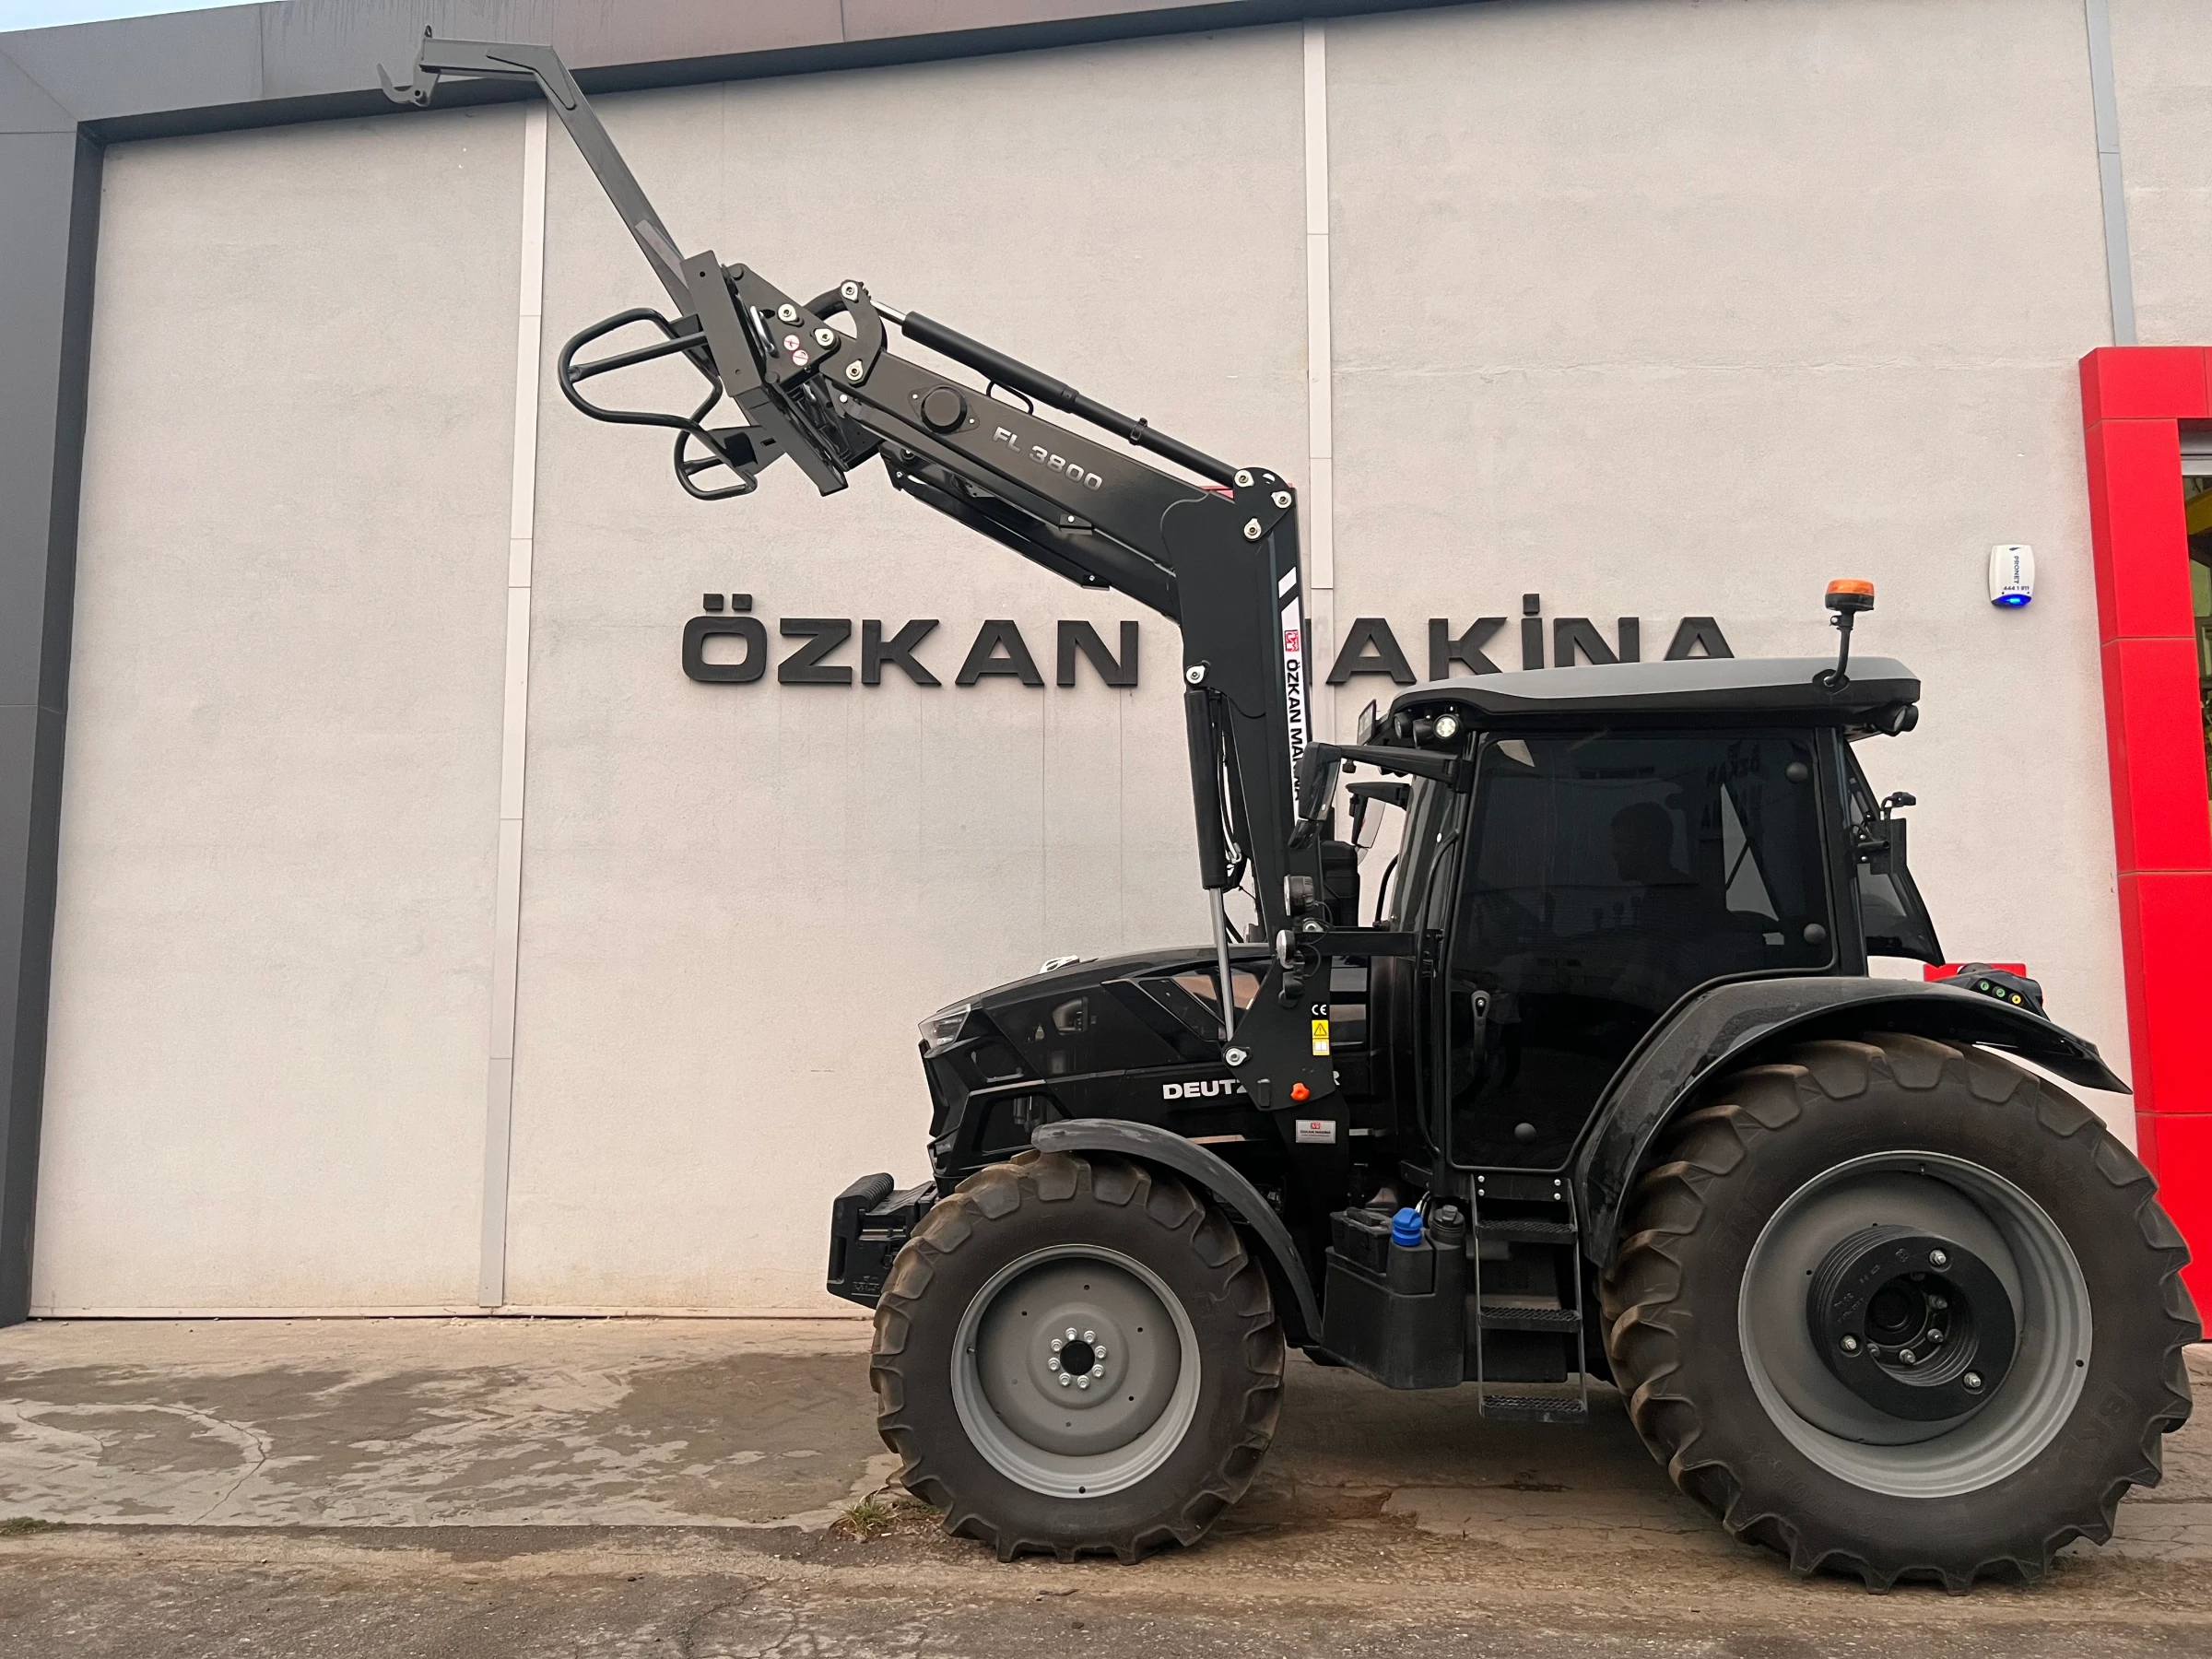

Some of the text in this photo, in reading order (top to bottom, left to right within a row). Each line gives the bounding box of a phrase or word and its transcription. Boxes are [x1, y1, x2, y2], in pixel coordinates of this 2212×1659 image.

[993, 426, 1103, 491] FL 3800
[682, 593, 1735, 686] ÖZKAN AKİNA
[1287, 659, 1301, 724] ÖZKAN
[1312, 1004, 1327, 1016] CE
